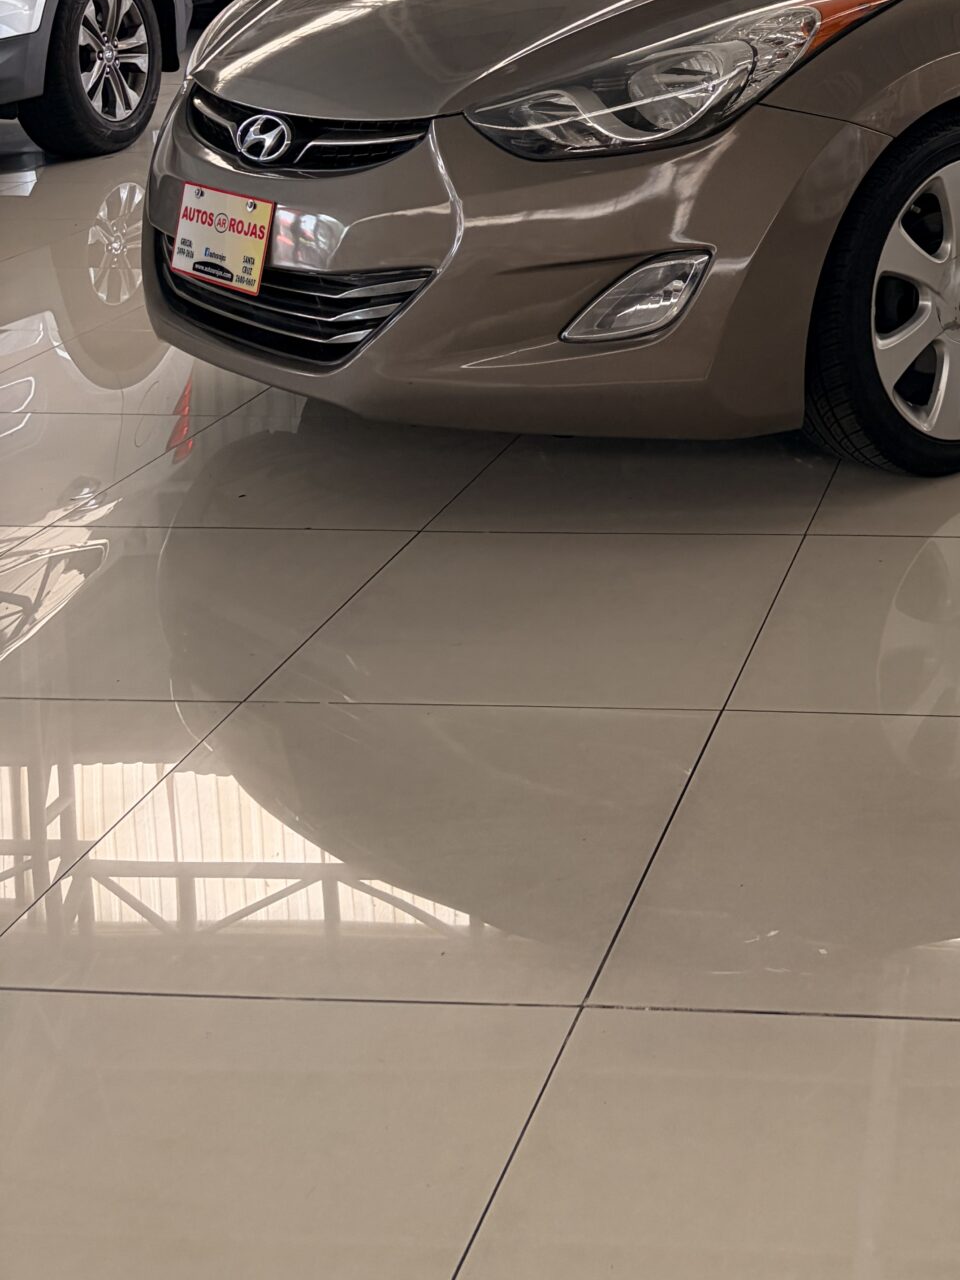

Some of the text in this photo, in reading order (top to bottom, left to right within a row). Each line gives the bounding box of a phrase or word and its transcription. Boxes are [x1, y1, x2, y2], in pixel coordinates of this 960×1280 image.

[182, 206, 266, 240] AUTOS AR ROJAS
[243, 255, 255, 265] SANTA
